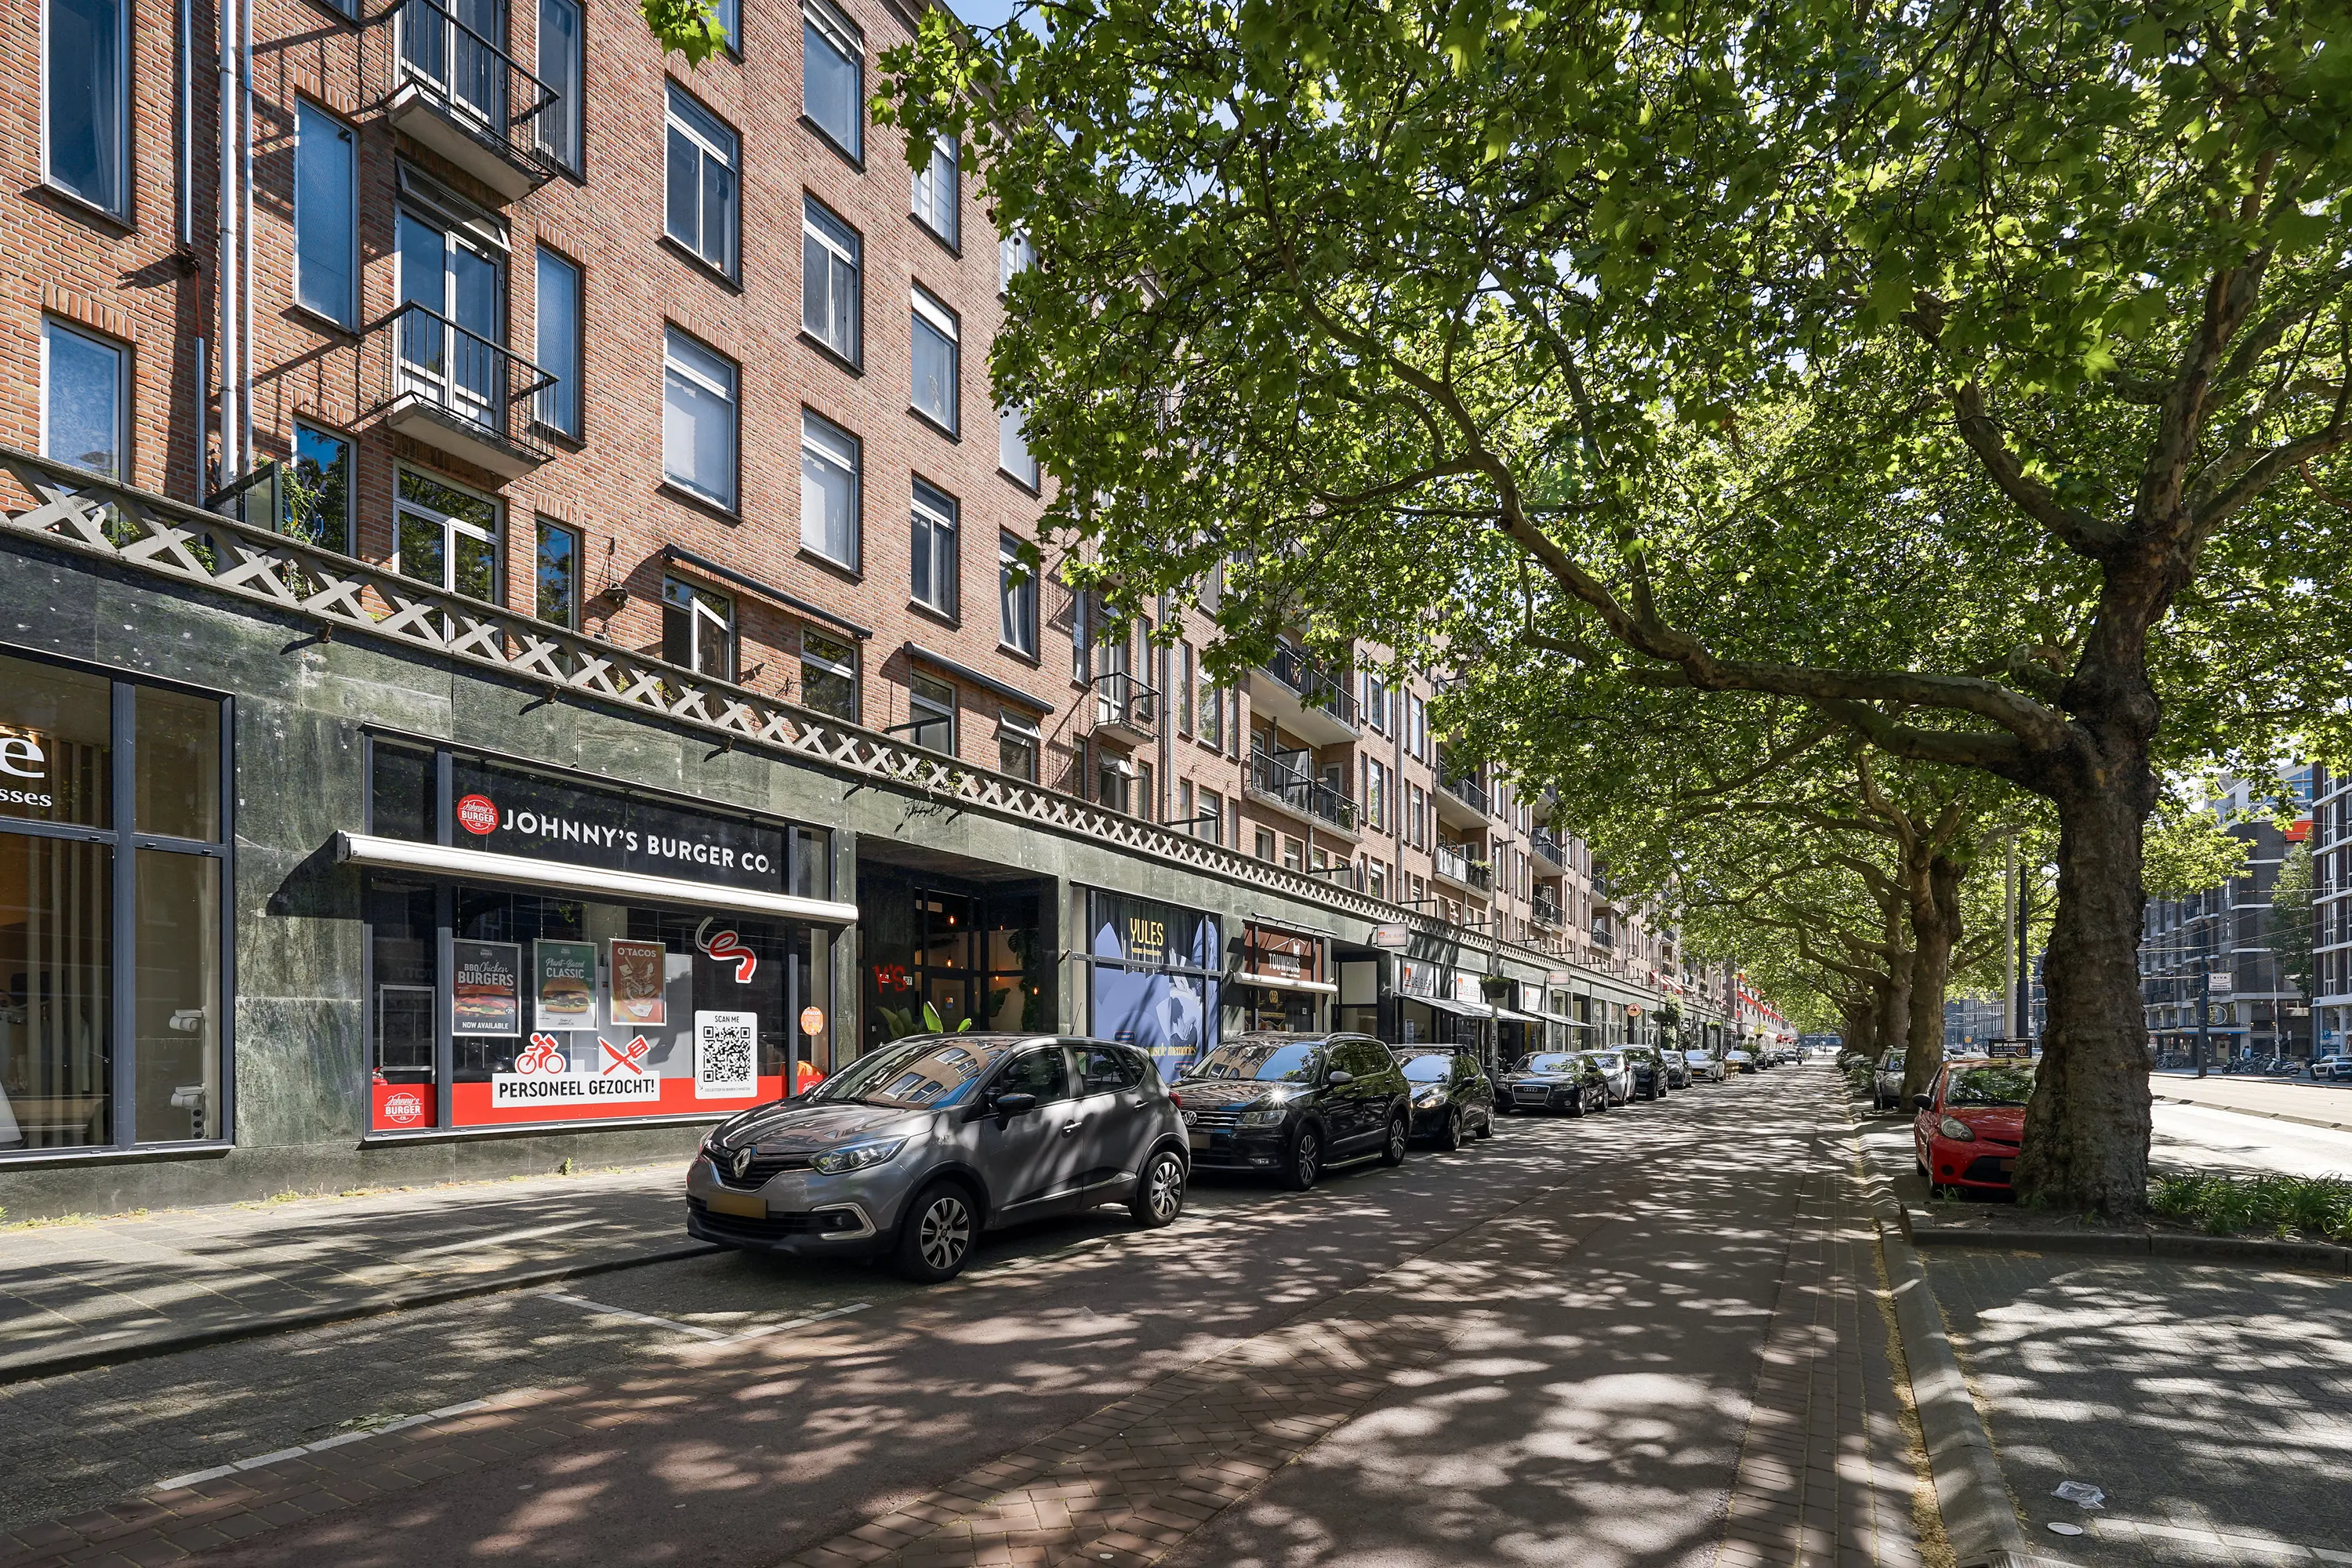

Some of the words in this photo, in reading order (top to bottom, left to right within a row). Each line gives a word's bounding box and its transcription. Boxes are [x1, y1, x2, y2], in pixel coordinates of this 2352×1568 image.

[461, 800, 495, 815] Johnny's
[461, 810, 495, 823] BURGER
[503, 809, 638, 851] JOHNNY'S
[648, 835, 734, 868] BURGER
[741, 852, 776, 874] CO.
[1130, 917, 1164, 946] YULES
[617, 947, 657, 957] O'TACOS
[464, 964, 479, 972] BBQ
[479, 961, 509, 973] Chicken
[545, 957, 585, 968] Plant-Based
[1268, 953, 1301, 973] TOUWHUIS
[458, 971, 514, 986] BURGERS
[546, 967, 585, 979] CLASSIC
[1412, 976, 1418, 986] DE
[1167, 1044, 1196, 1057] memories
[499, 1080, 585, 1098] PERSONEEL
[589, 1079, 655, 1095] GEZOCHT!
[387, 1095, 420, 1106] Johnny's
[385, 1105, 421, 1115] BURGER
